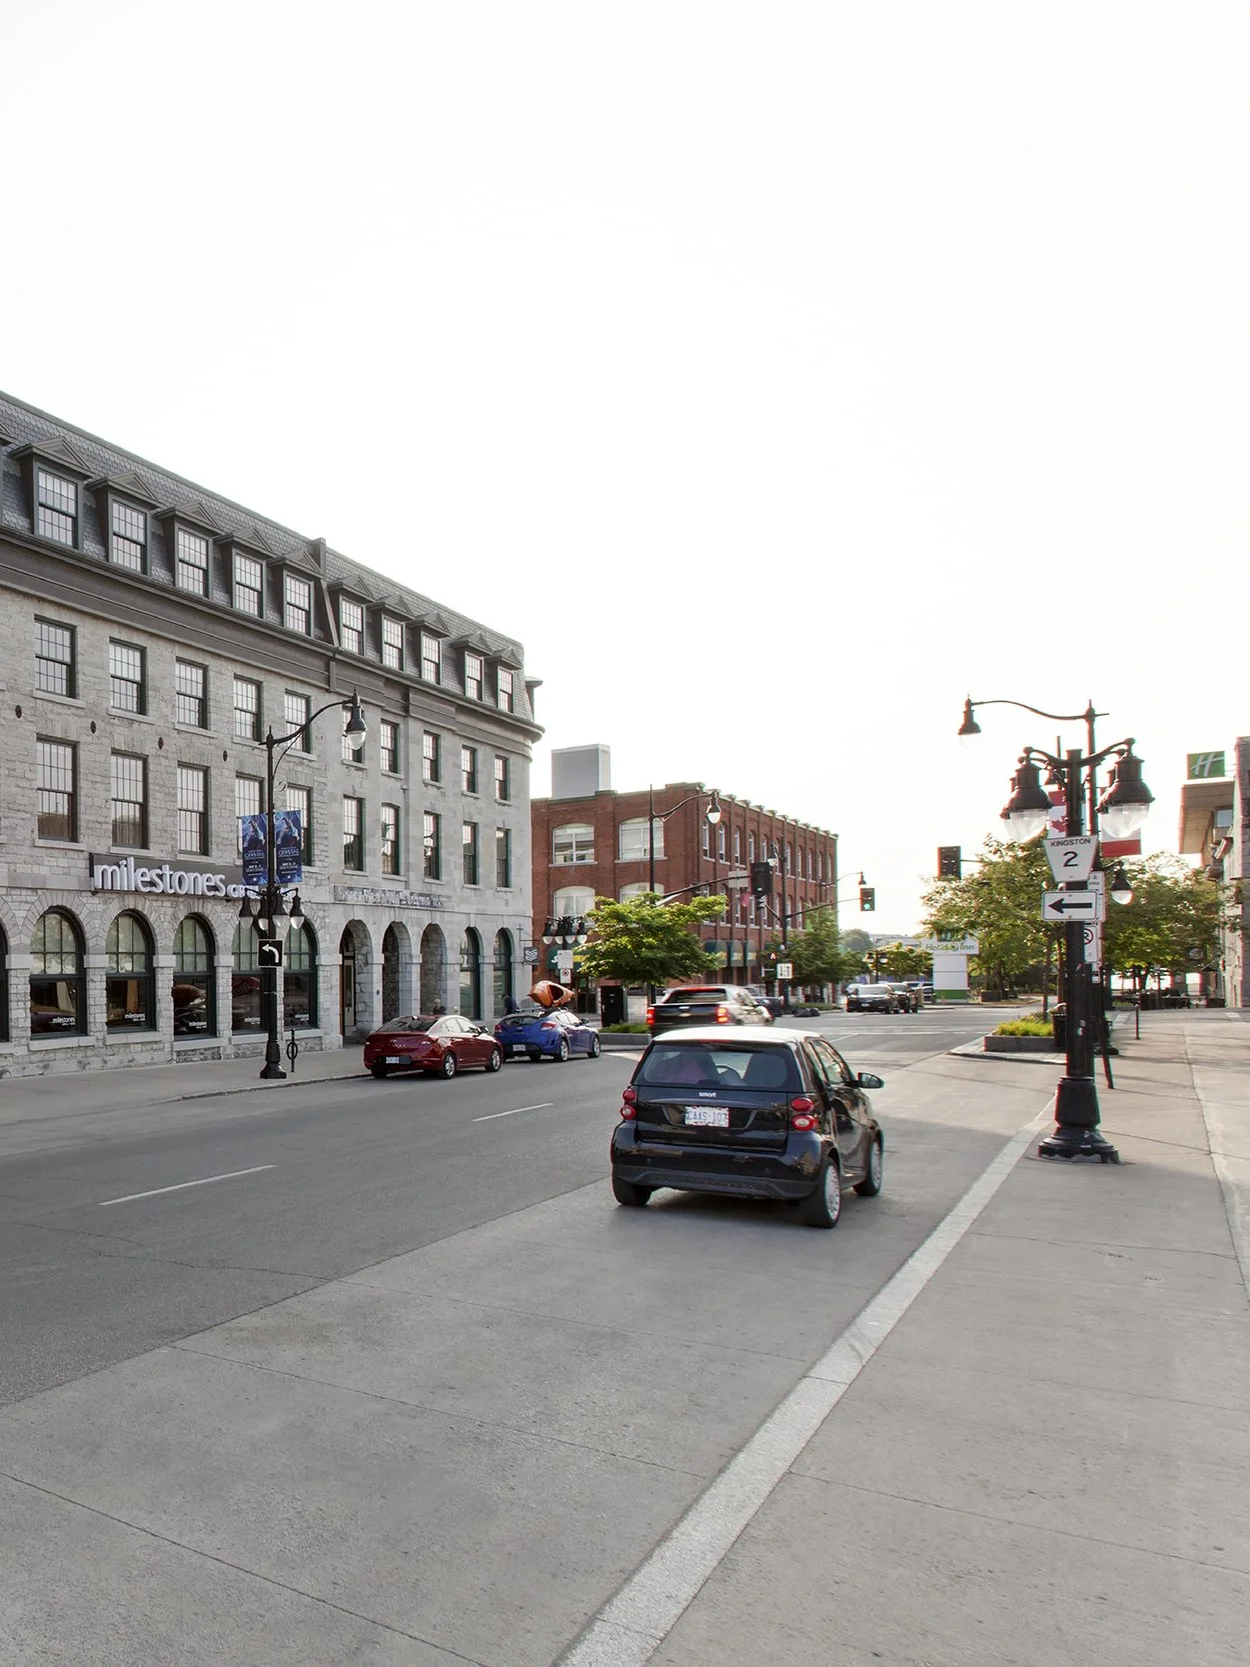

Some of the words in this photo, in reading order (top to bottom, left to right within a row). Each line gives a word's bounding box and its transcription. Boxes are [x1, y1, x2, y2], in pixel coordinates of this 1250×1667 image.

[1050, 838, 1091, 847] KINGSTON
[1062, 851, 1079, 868] 2
[94, 856, 226, 897] milestones
